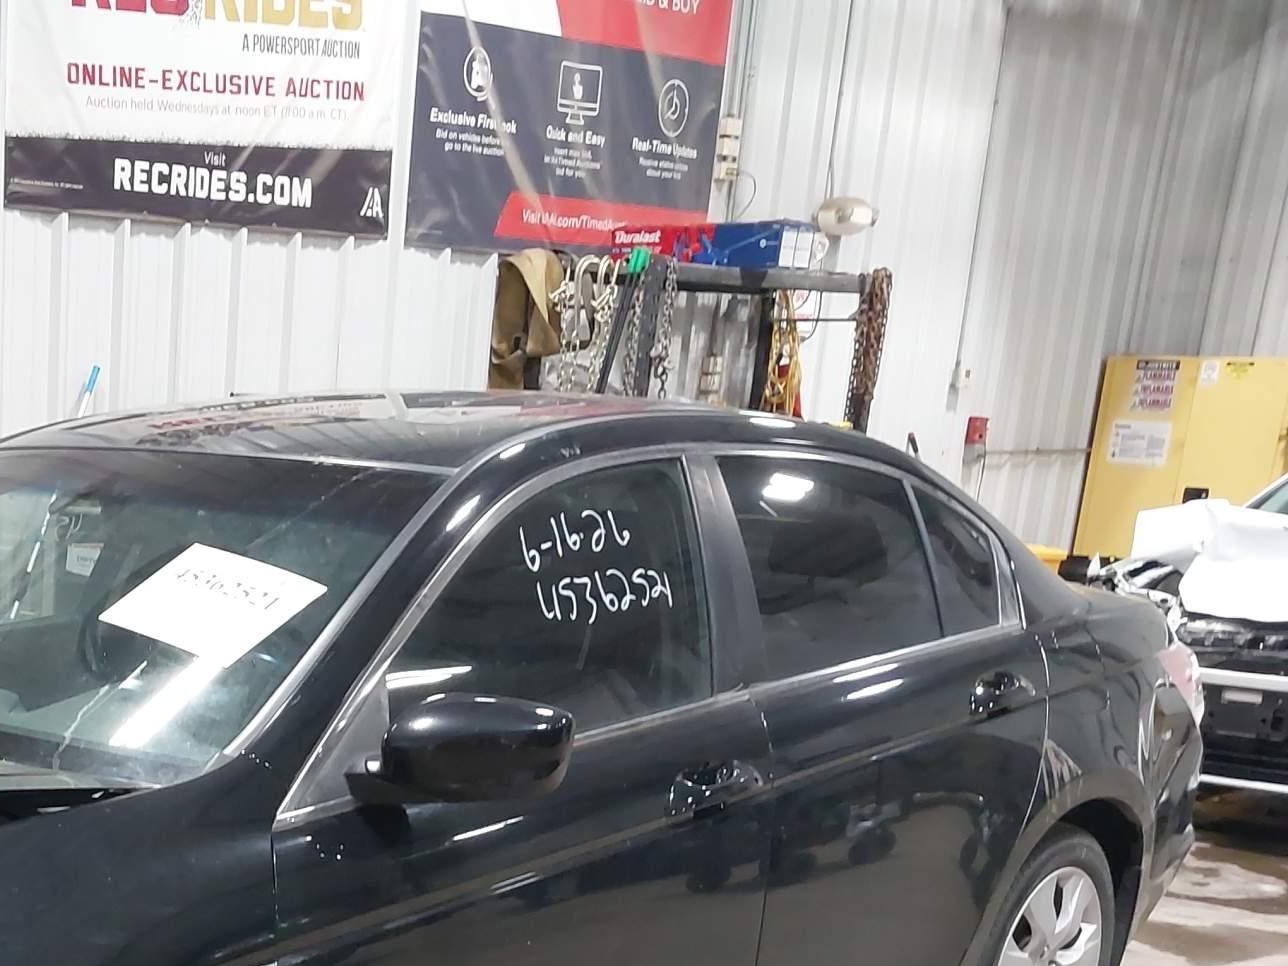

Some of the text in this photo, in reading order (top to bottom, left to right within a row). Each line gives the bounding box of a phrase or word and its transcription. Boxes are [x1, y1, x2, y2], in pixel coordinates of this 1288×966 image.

[242, 33, 361, 59] A POWERSPORT AUCTION
[67, 62, 365, 102] ONLINE-EXCLUSIVE AUCTION
[85, 96, 128, 110] Auction
[130, 99, 154, 111] held
[157, 100, 220, 116] Wednesdays
[221, 104, 231, 115] at
[430, 107, 476, 127] Exclusive
[546, 125, 606, 148] Quick and Easy
[204, 151, 226, 166] Visit
[113, 157, 312, 208] RECRIDES.COM
[614, 229, 662, 244] Duralast
